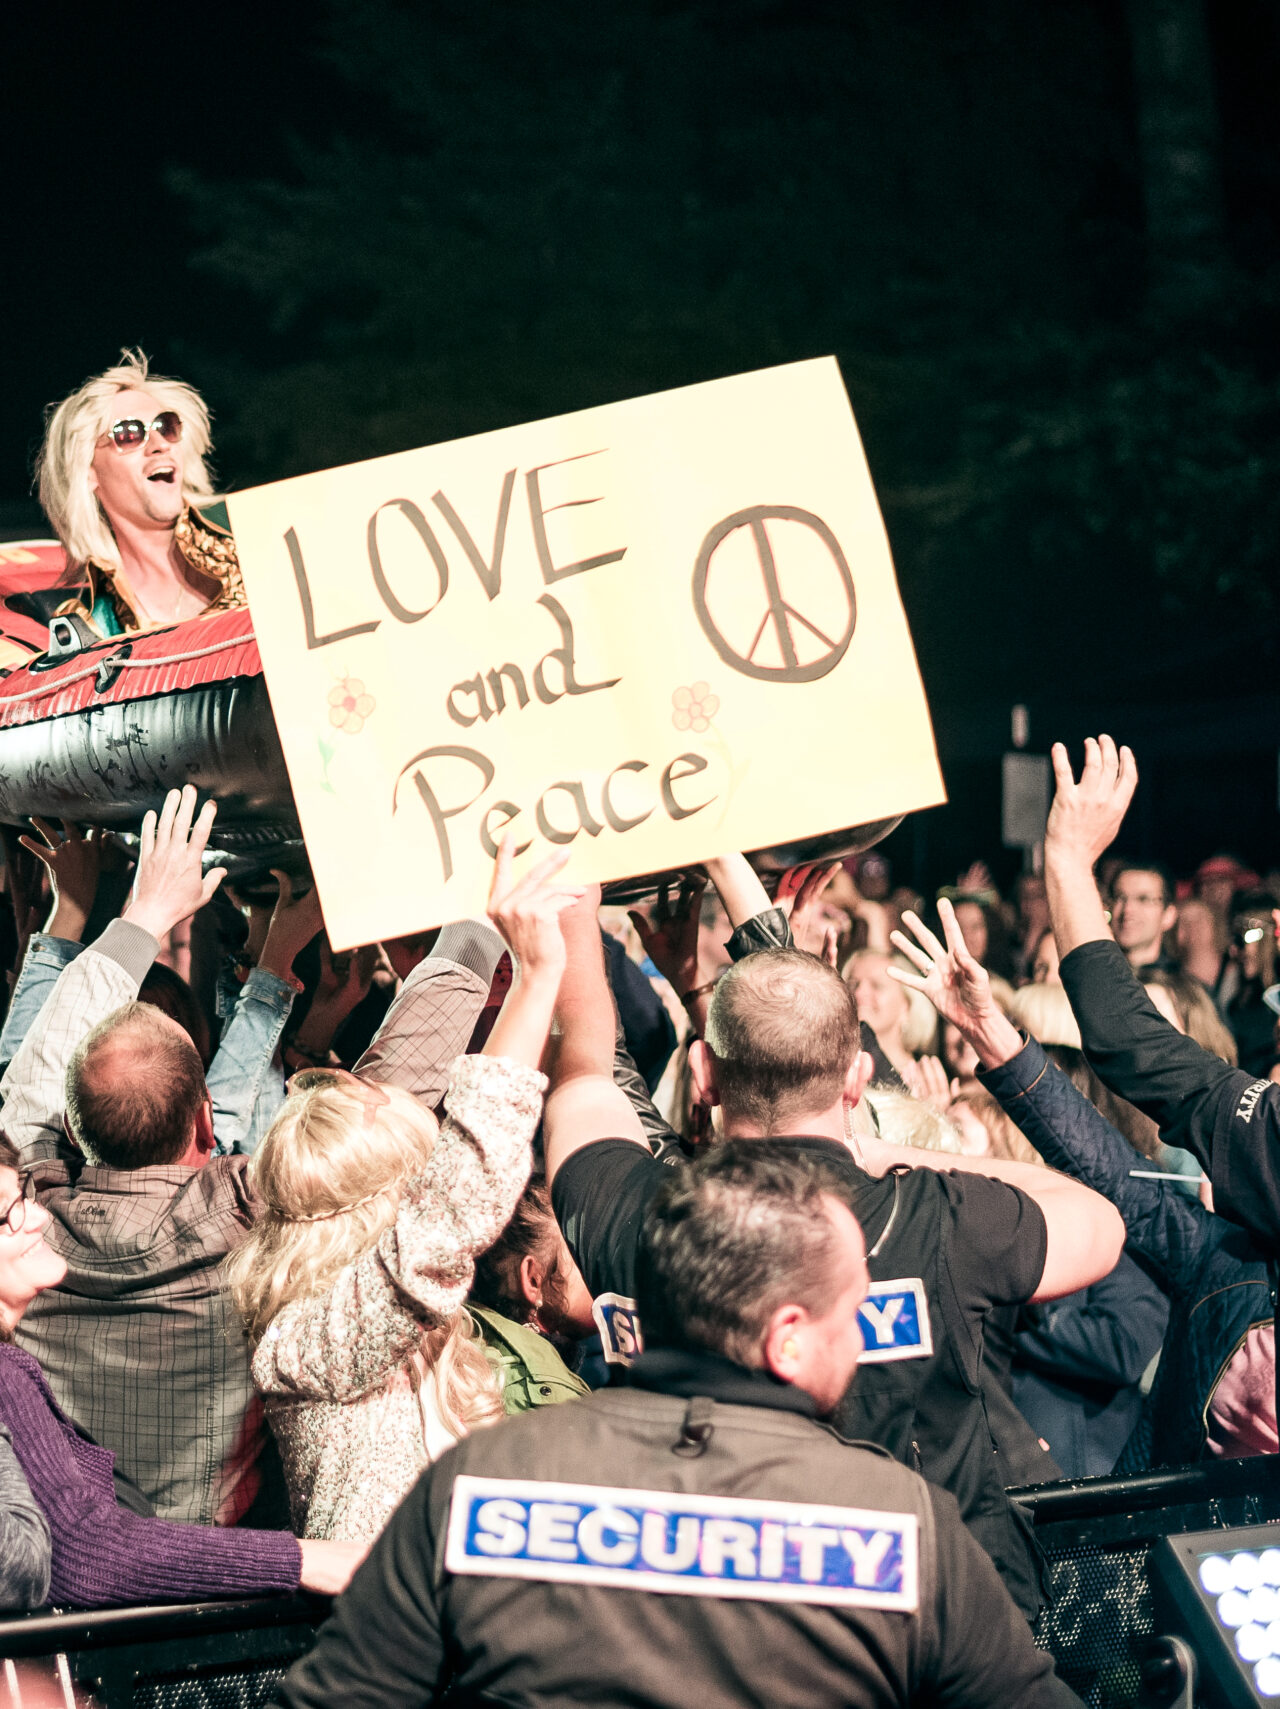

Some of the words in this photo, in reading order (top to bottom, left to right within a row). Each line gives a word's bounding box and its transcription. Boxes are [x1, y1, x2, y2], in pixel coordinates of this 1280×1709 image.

[283, 448, 628, 651] LOVE
[445, 593, 623, 728] and
[392, 744, 719, 883] Peace
[474, 1498, 895, 1587] SECURITY
